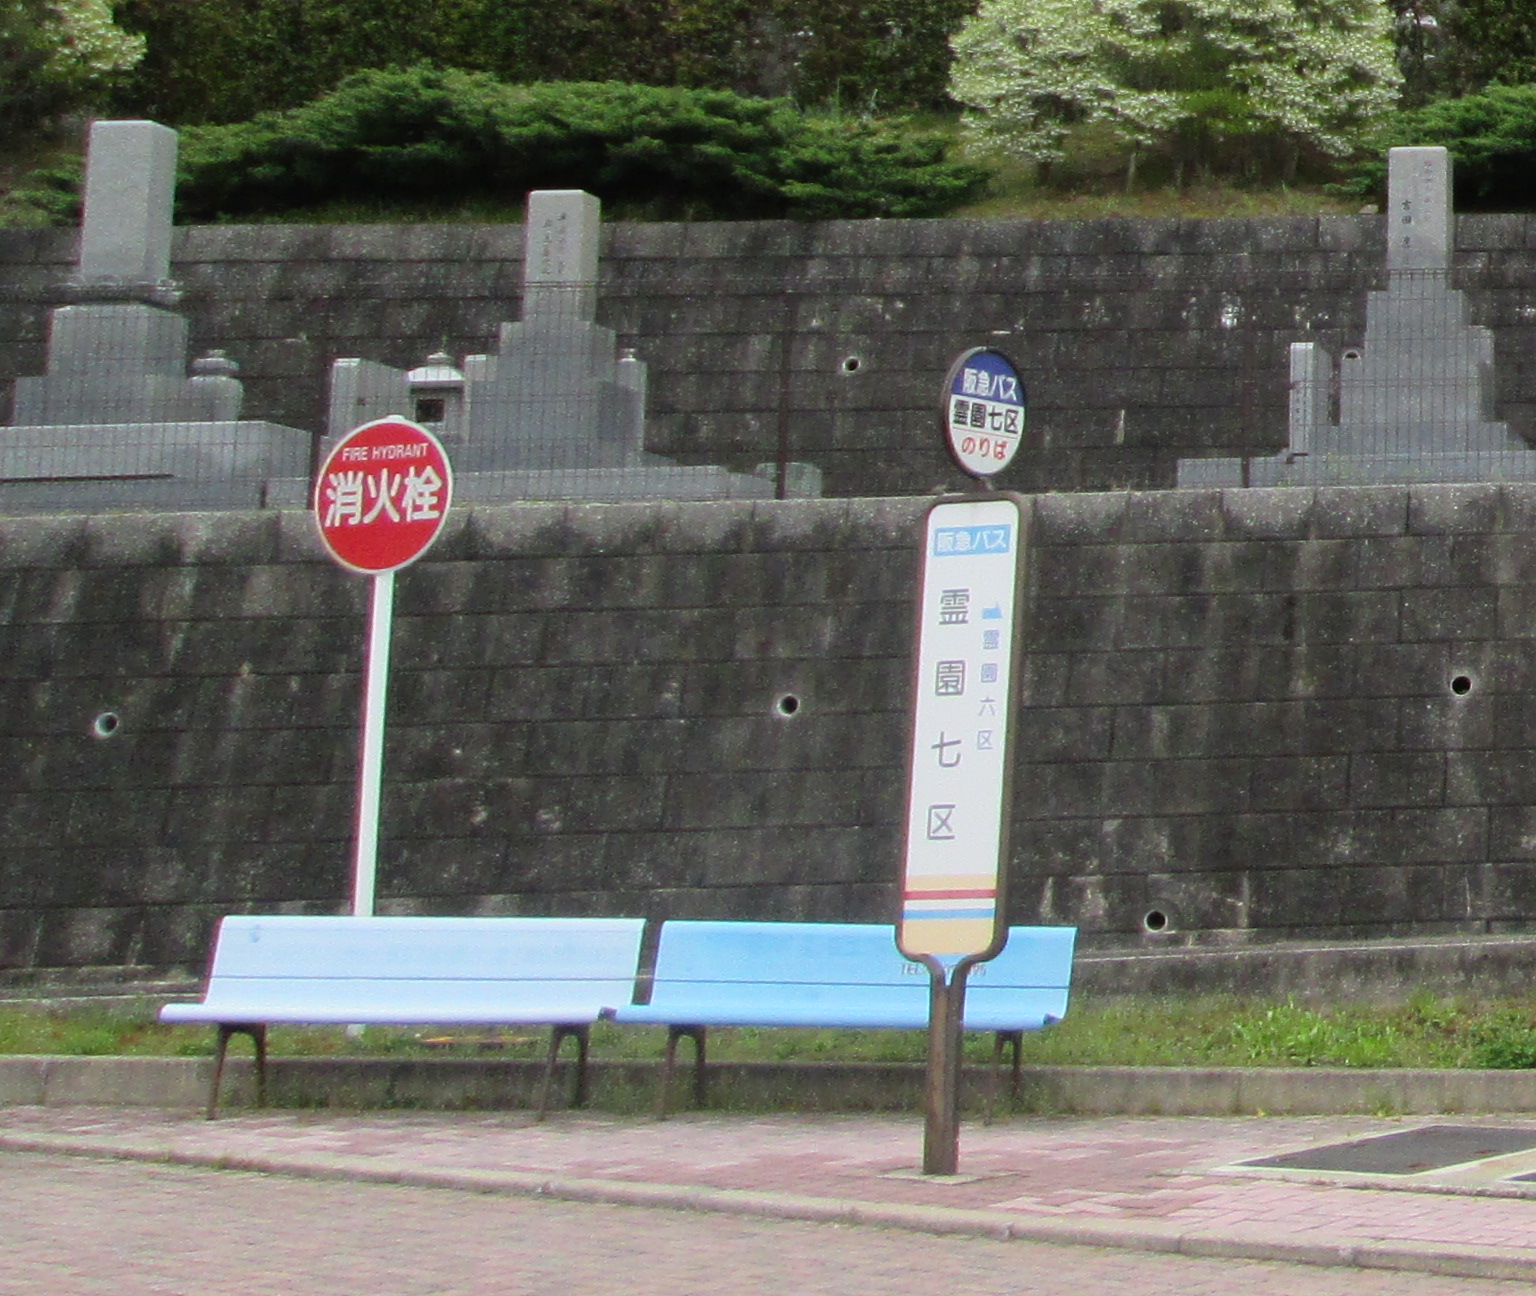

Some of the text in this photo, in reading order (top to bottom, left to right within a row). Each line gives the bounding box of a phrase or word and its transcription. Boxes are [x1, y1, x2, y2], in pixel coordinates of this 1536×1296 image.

[963, 368, 1018, 402] 阪急バス
[952, 399, 1019, 434] 霊園七区
[342, 442, 430, 462] FIRE HYDRANT
[961, 436, 1009, 461] のりば
[324, 465, 443, 527] 消火栓
[936, 529, 1008, 553] 阪急バス
[976, 629, 1000, 750] 霊園六区
[926, 588, 971, 841] 霊園七区
